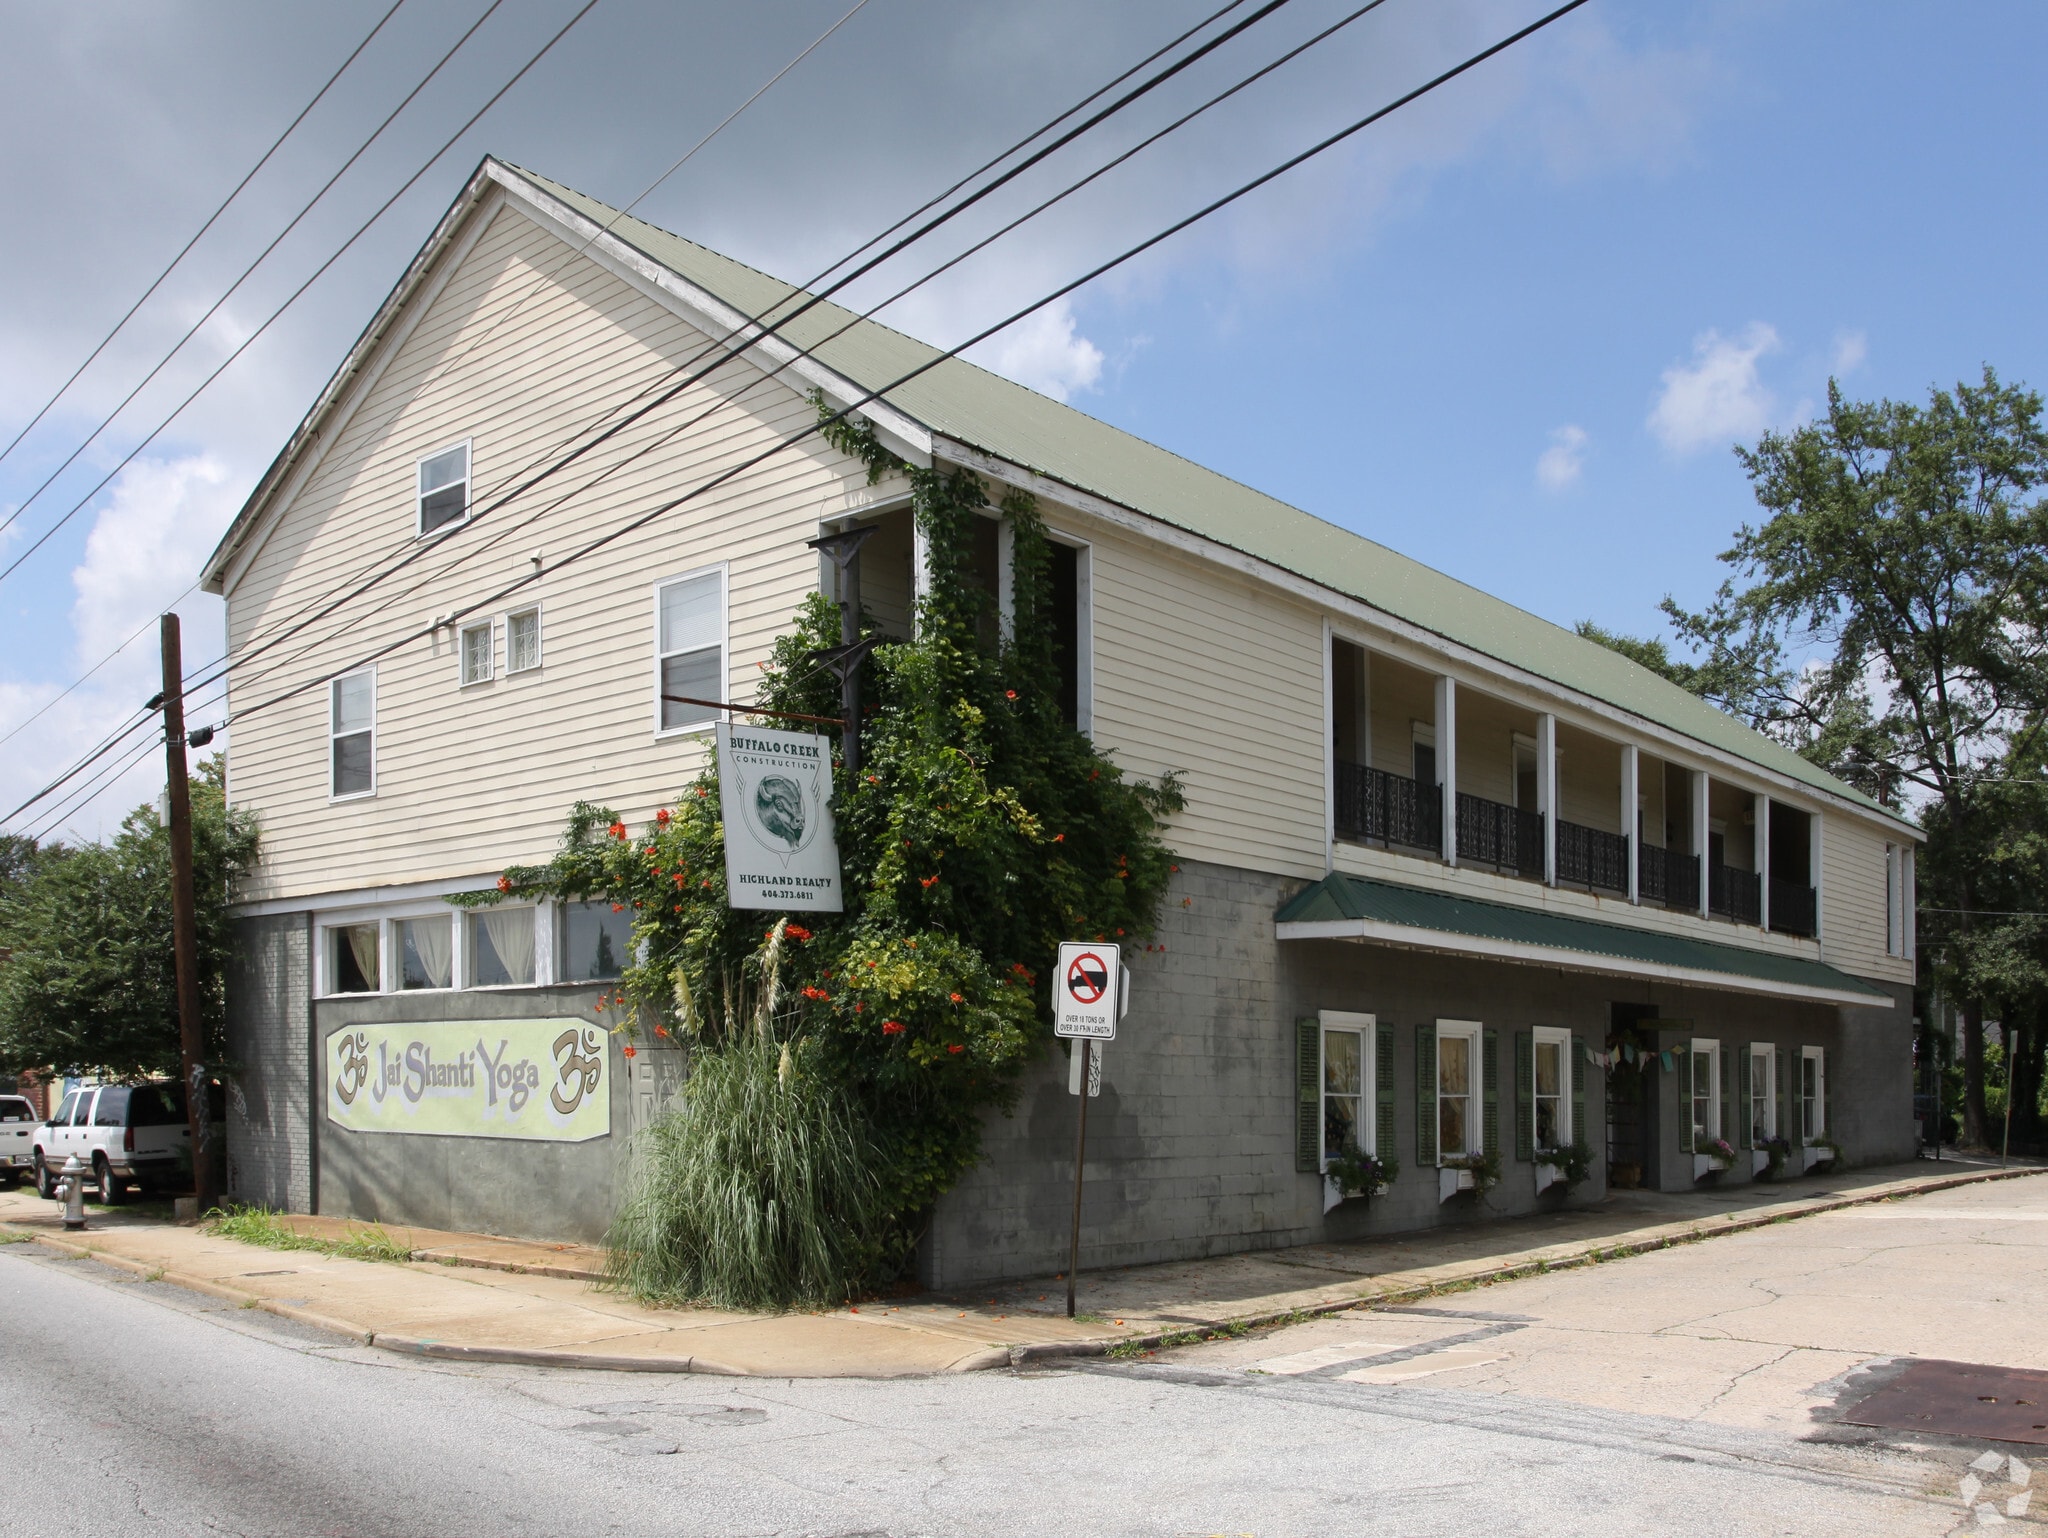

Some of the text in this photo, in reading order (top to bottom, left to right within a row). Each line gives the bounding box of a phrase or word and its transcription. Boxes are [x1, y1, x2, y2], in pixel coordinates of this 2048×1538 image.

[730, 737, 820, 758] BUFFALO CREEK
[736, 755, 816, 770] CONSTRUCTION
[795, 877, 832, 888] REALTY
[762, 889, 814, 900] 404.373.6811
[1065, 1014, 1079, 1023] OVER
[1085, 1015, 1098, 1024] TONS
[1098, 1016, 1106, 1024] OR
[1060, 1023, 1073, 1032] OVER
[1091, 1025, 1111, 1035] LENGTH
[372, 1037, 540, 1113] Jai Shanti Yoga
